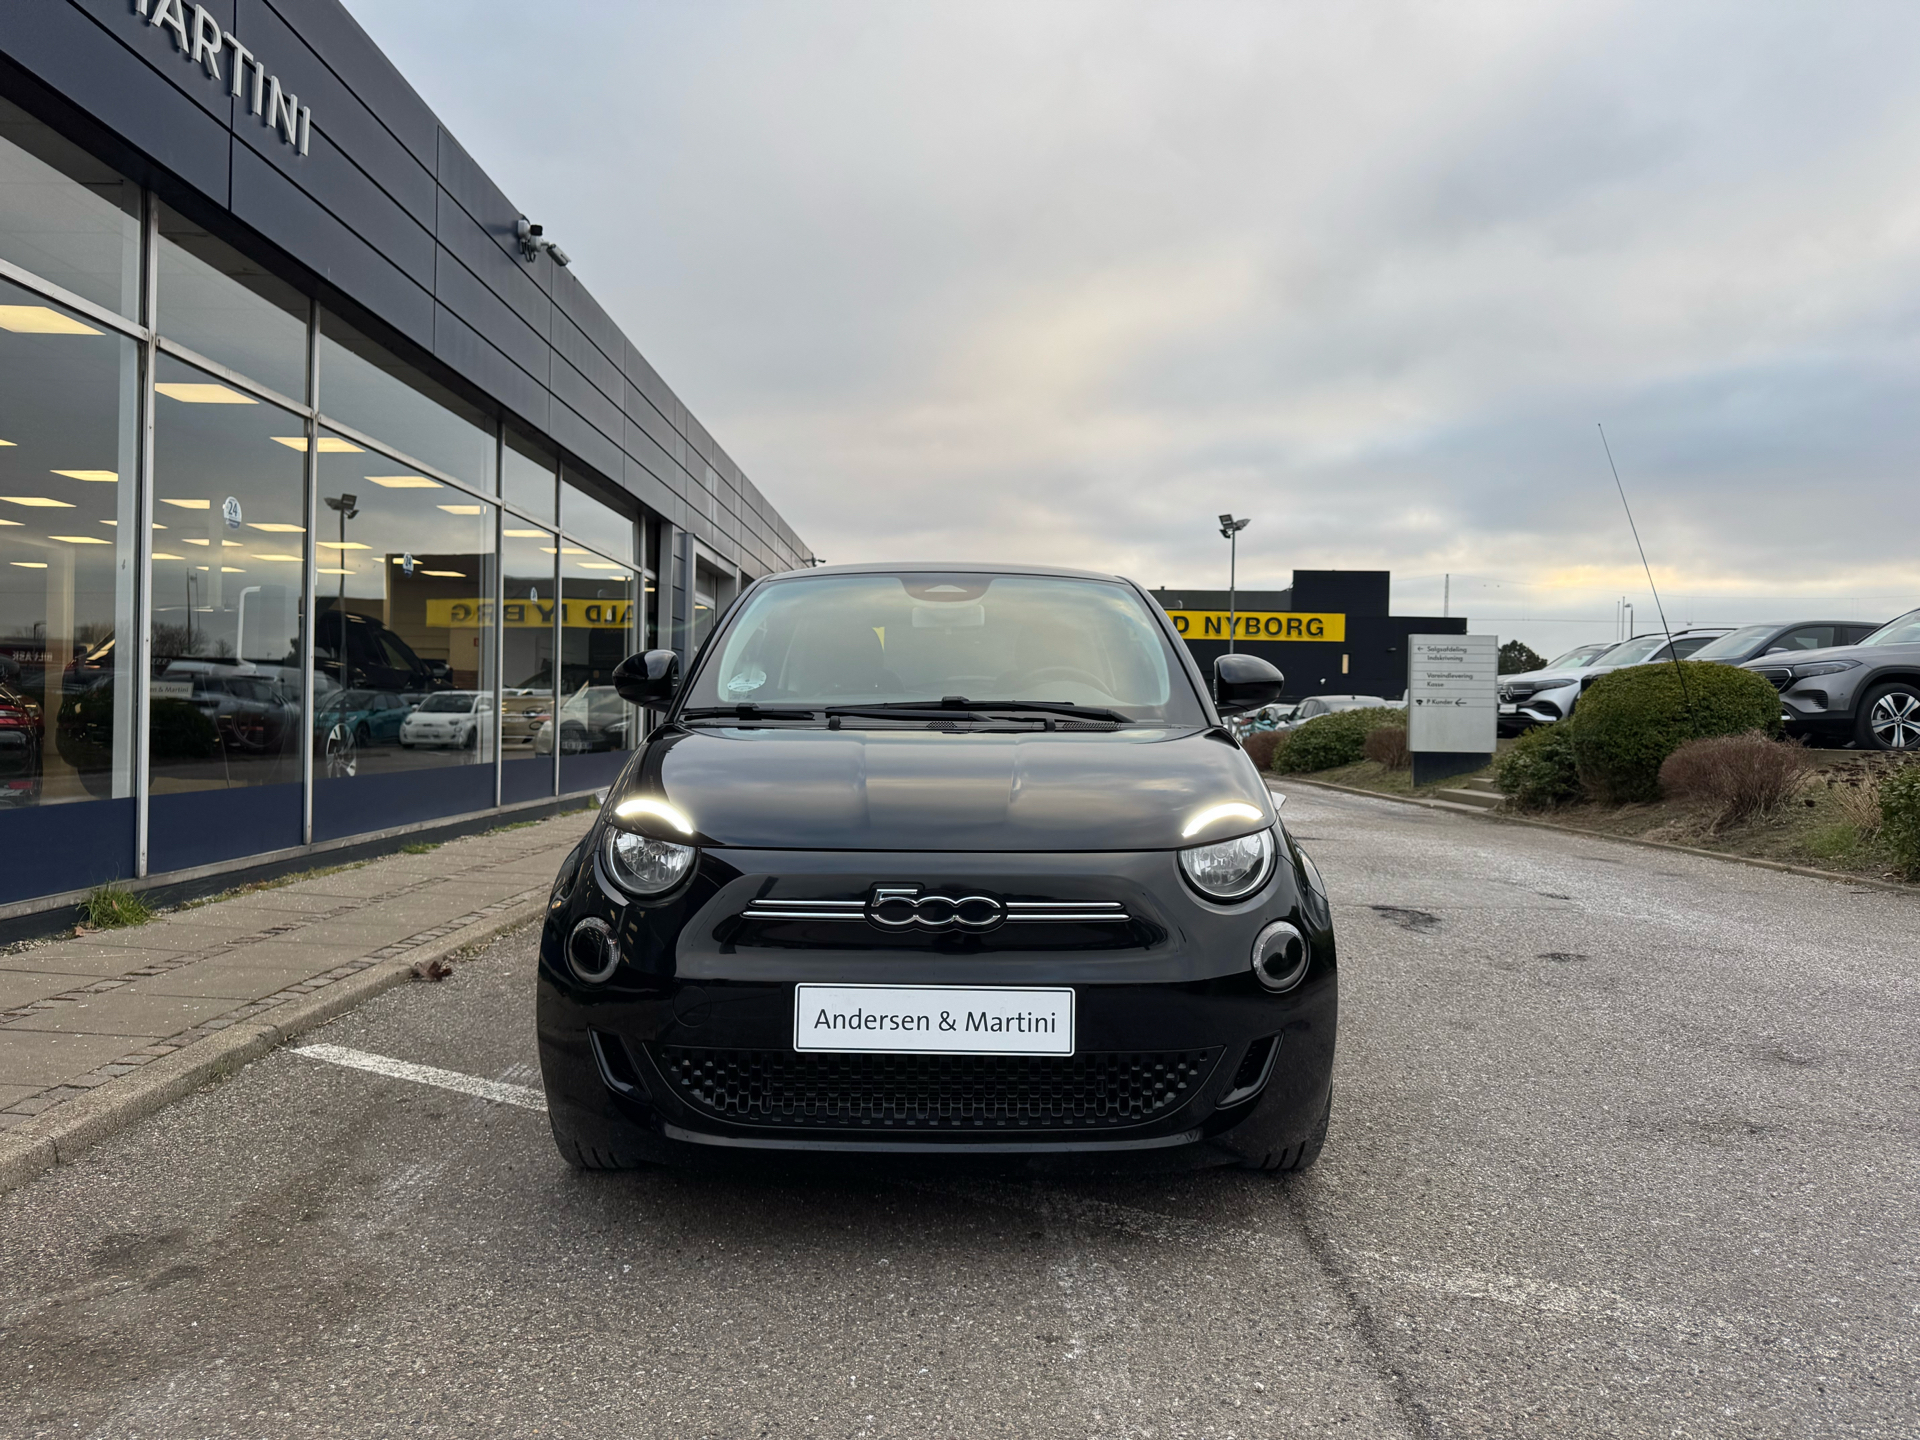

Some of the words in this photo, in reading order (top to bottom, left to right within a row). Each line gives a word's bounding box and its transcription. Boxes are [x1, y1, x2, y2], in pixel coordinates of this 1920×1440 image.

[136, 0, 311, 157] ARTINI
[228, 501, 238, 517] 24
[1204, 616, 1325, 637] NYBORG
[870, 888, 1001, 926] 500
[814, 1008, 930, 1031] Andersen
[938, 1010, 957, 1032] &
[965, 1011, 1057, 1033] Martini
